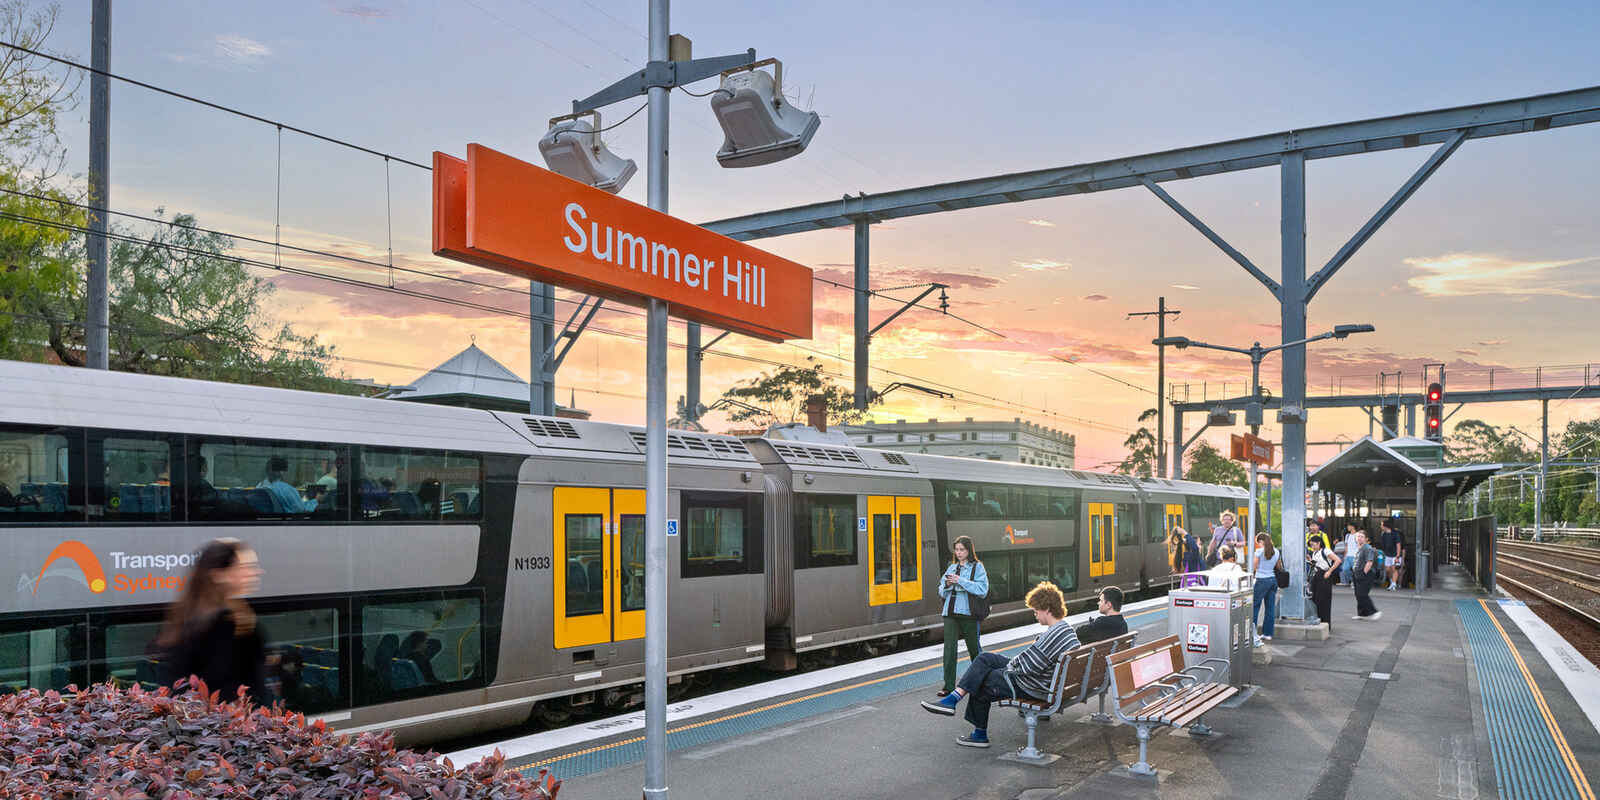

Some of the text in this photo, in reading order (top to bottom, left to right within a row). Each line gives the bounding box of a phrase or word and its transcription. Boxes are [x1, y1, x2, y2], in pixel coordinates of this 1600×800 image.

[563, 202, 766, 308] Summer Hill
[109, 551, 201, 571] Transpor
[514, 556, 551, 570] N1933
[113, 572, 187, 594] Sydney
